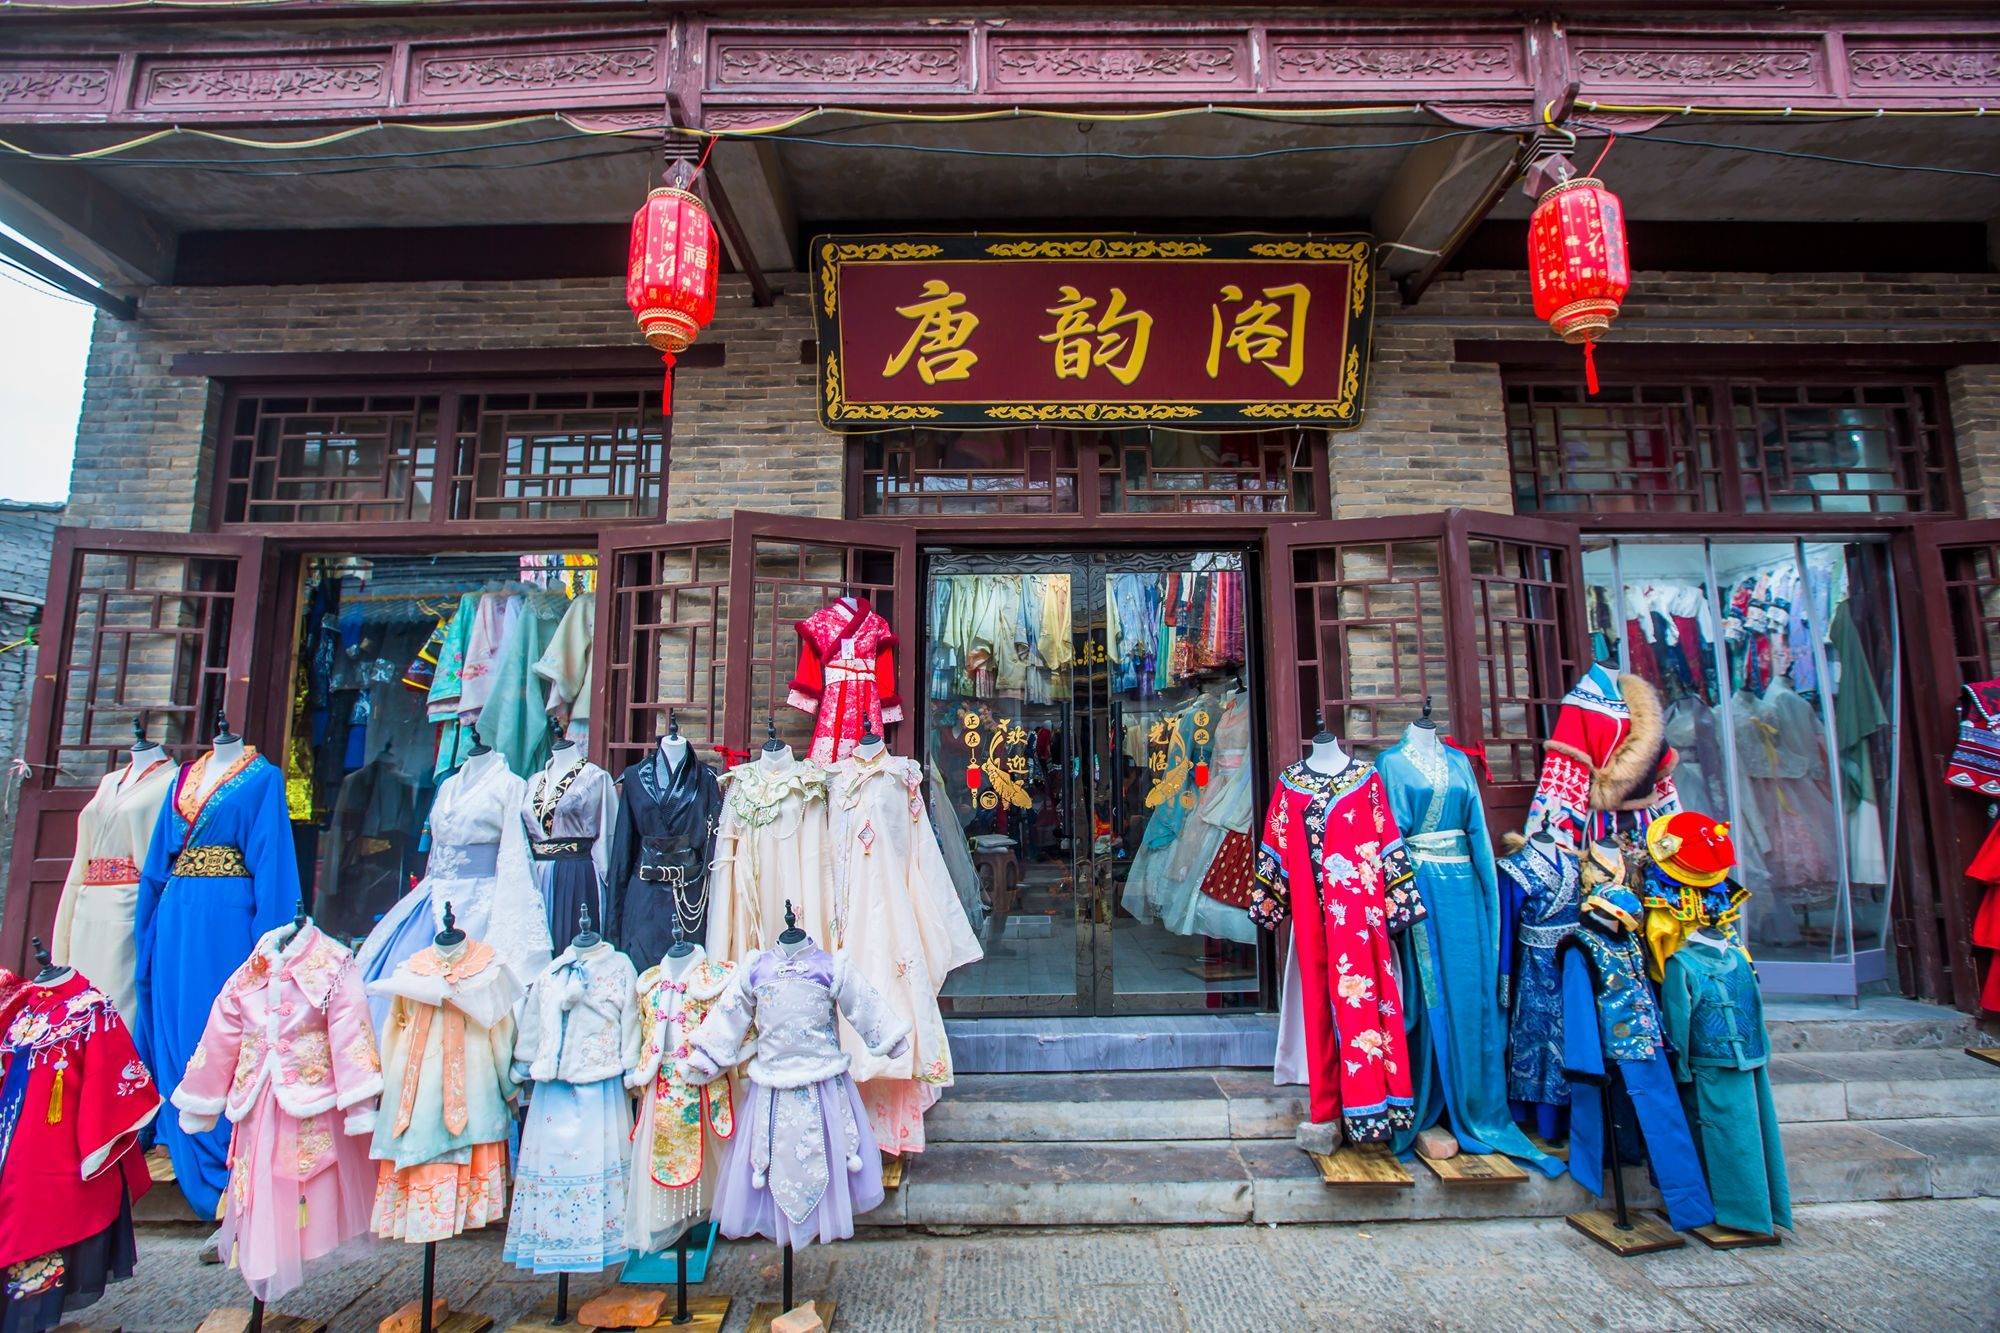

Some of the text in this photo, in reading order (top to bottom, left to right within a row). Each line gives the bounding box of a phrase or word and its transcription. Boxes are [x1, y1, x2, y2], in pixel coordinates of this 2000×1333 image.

[882, 279, 1311, 387] 唐韵阁
[966, 714, 979, 746] 正在
[1006, 725, 1029, 774] 欢迎
[1149, 721, 1169, 772] 光临
